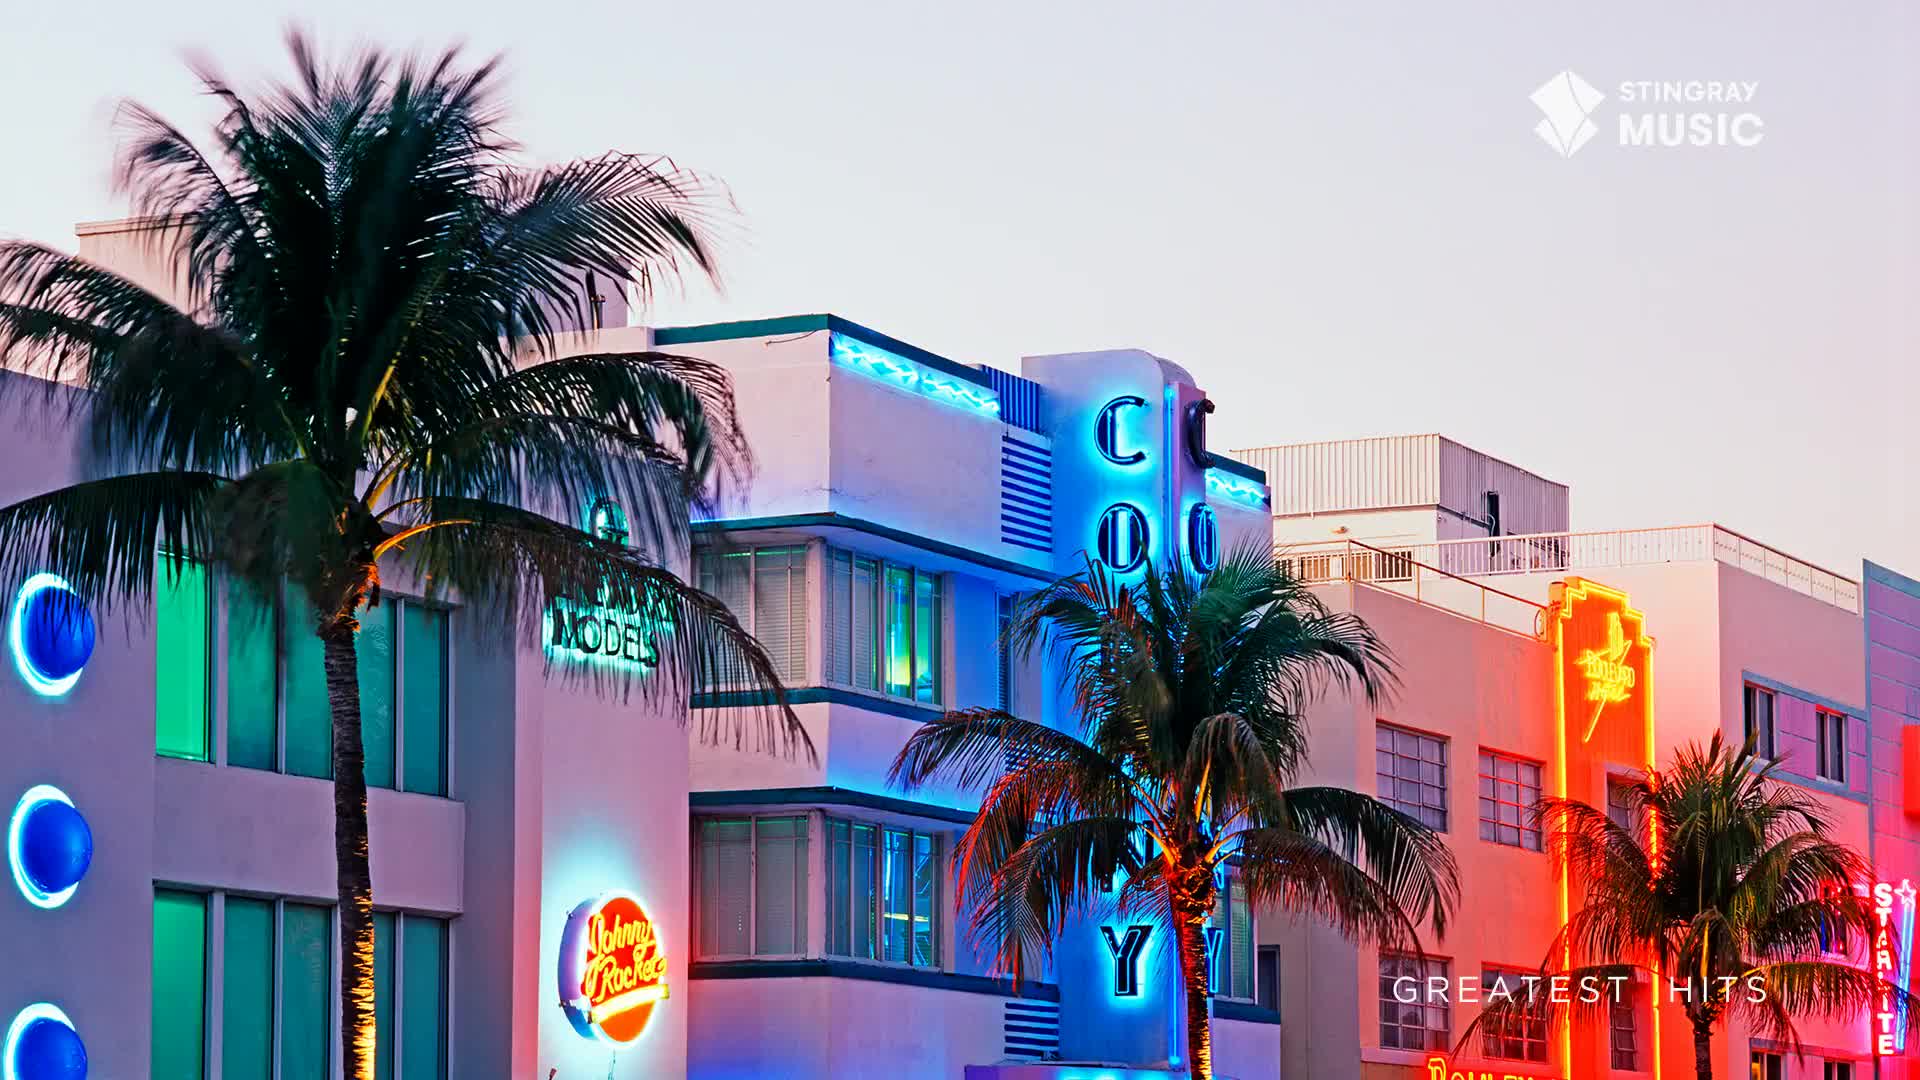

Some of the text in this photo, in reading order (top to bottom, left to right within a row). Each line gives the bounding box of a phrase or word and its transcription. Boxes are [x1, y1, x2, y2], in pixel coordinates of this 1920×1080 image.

[552, 609, 658, 667] MODELS
[1094, 396, 1154, 996] CONY
[591, 913, 656, 960] Johnny
